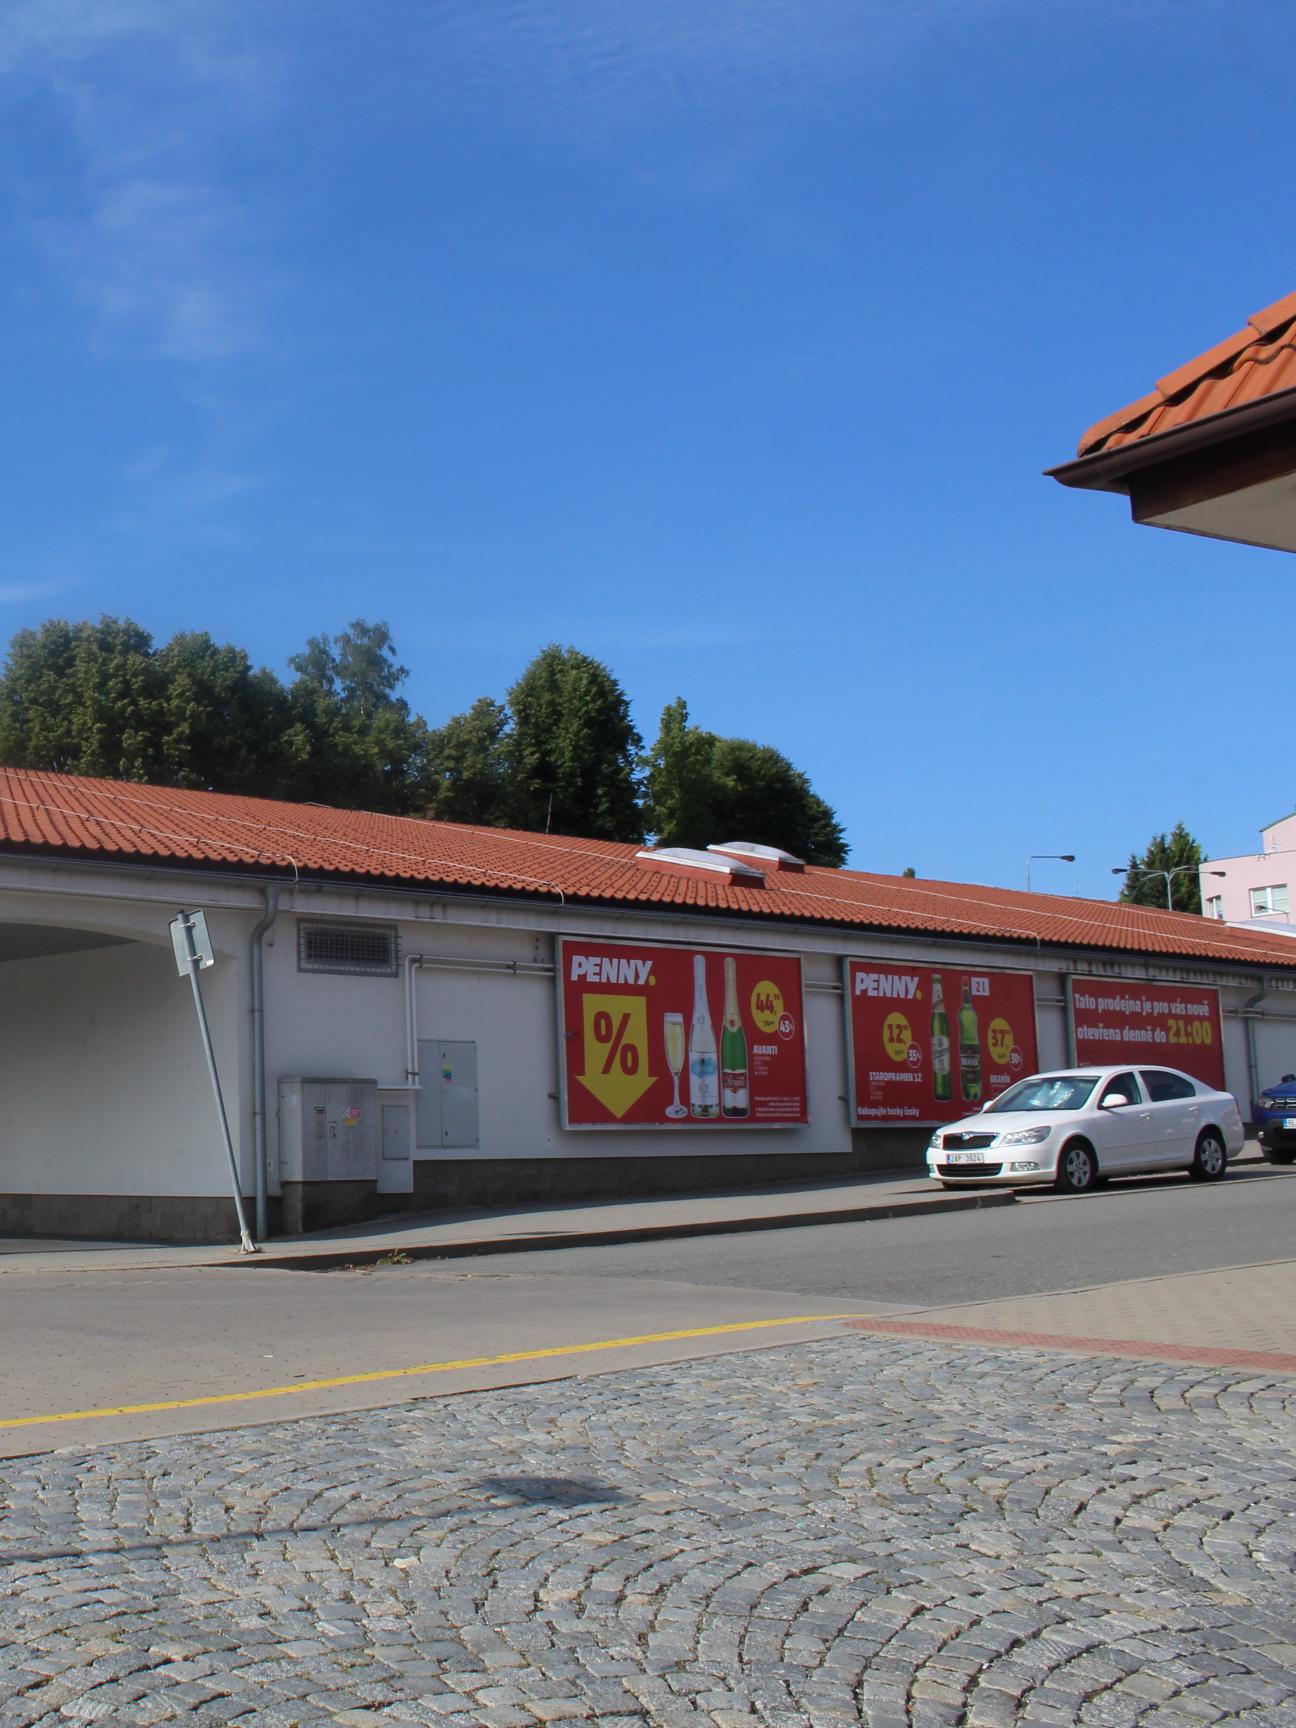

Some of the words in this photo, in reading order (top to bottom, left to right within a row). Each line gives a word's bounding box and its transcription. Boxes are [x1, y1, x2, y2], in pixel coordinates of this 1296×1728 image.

[1075, 994, 1095, 1009] Tato
[1098, 995, 1141, 1014] prodejna
[1142, 996, 1152, 1015] je
[1153, 1001, 1168, 1016] pro
[1170, 999, 1185, 1015] vás
[1187, 1001, 1209, 1016] nově
[1077, 1023, 1120, 1040] otevřena
[1123, 1026, 1153, 1042] denně
[1154, 1028, 1167, 1042] do
[1168, 1019, 1212, 1045] 21:00
